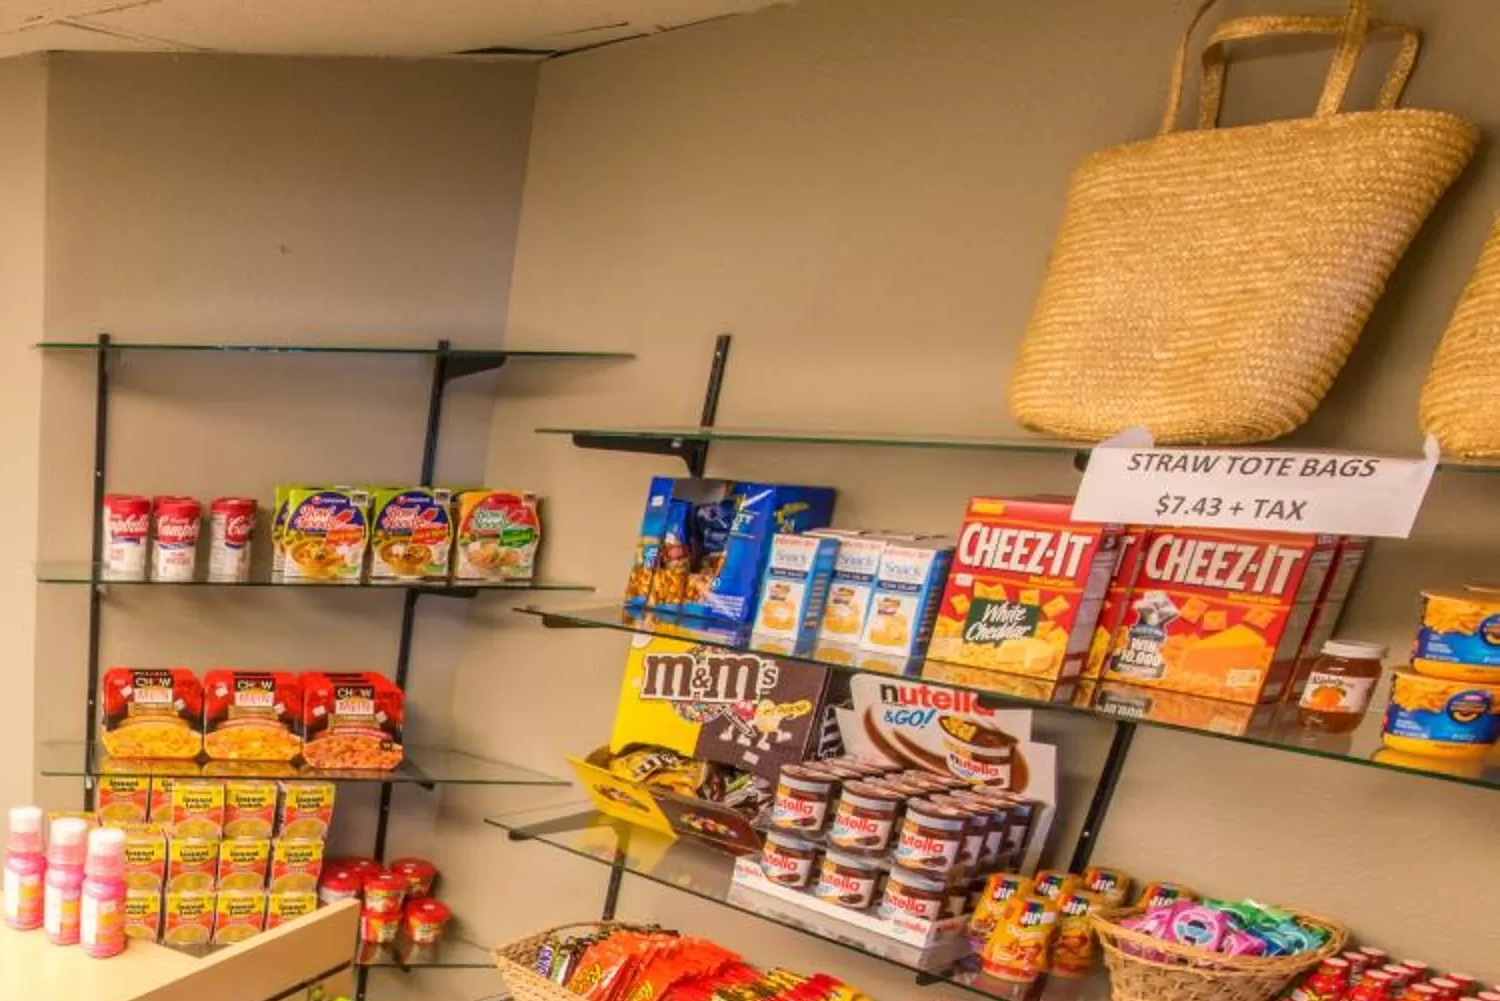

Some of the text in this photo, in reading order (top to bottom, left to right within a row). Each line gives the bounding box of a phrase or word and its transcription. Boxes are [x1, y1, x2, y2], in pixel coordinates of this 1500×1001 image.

[1127, 452, 1380, 478] STRAW TOTE BAGS
[1155, 493, 1309, 521] $7.43 + TAX
[957, 522, 1093, 578] CHEEZ-IT
[1145, 533, 1304, 595] CHEEZ-IT
[981, 600, 1027, 622] White
